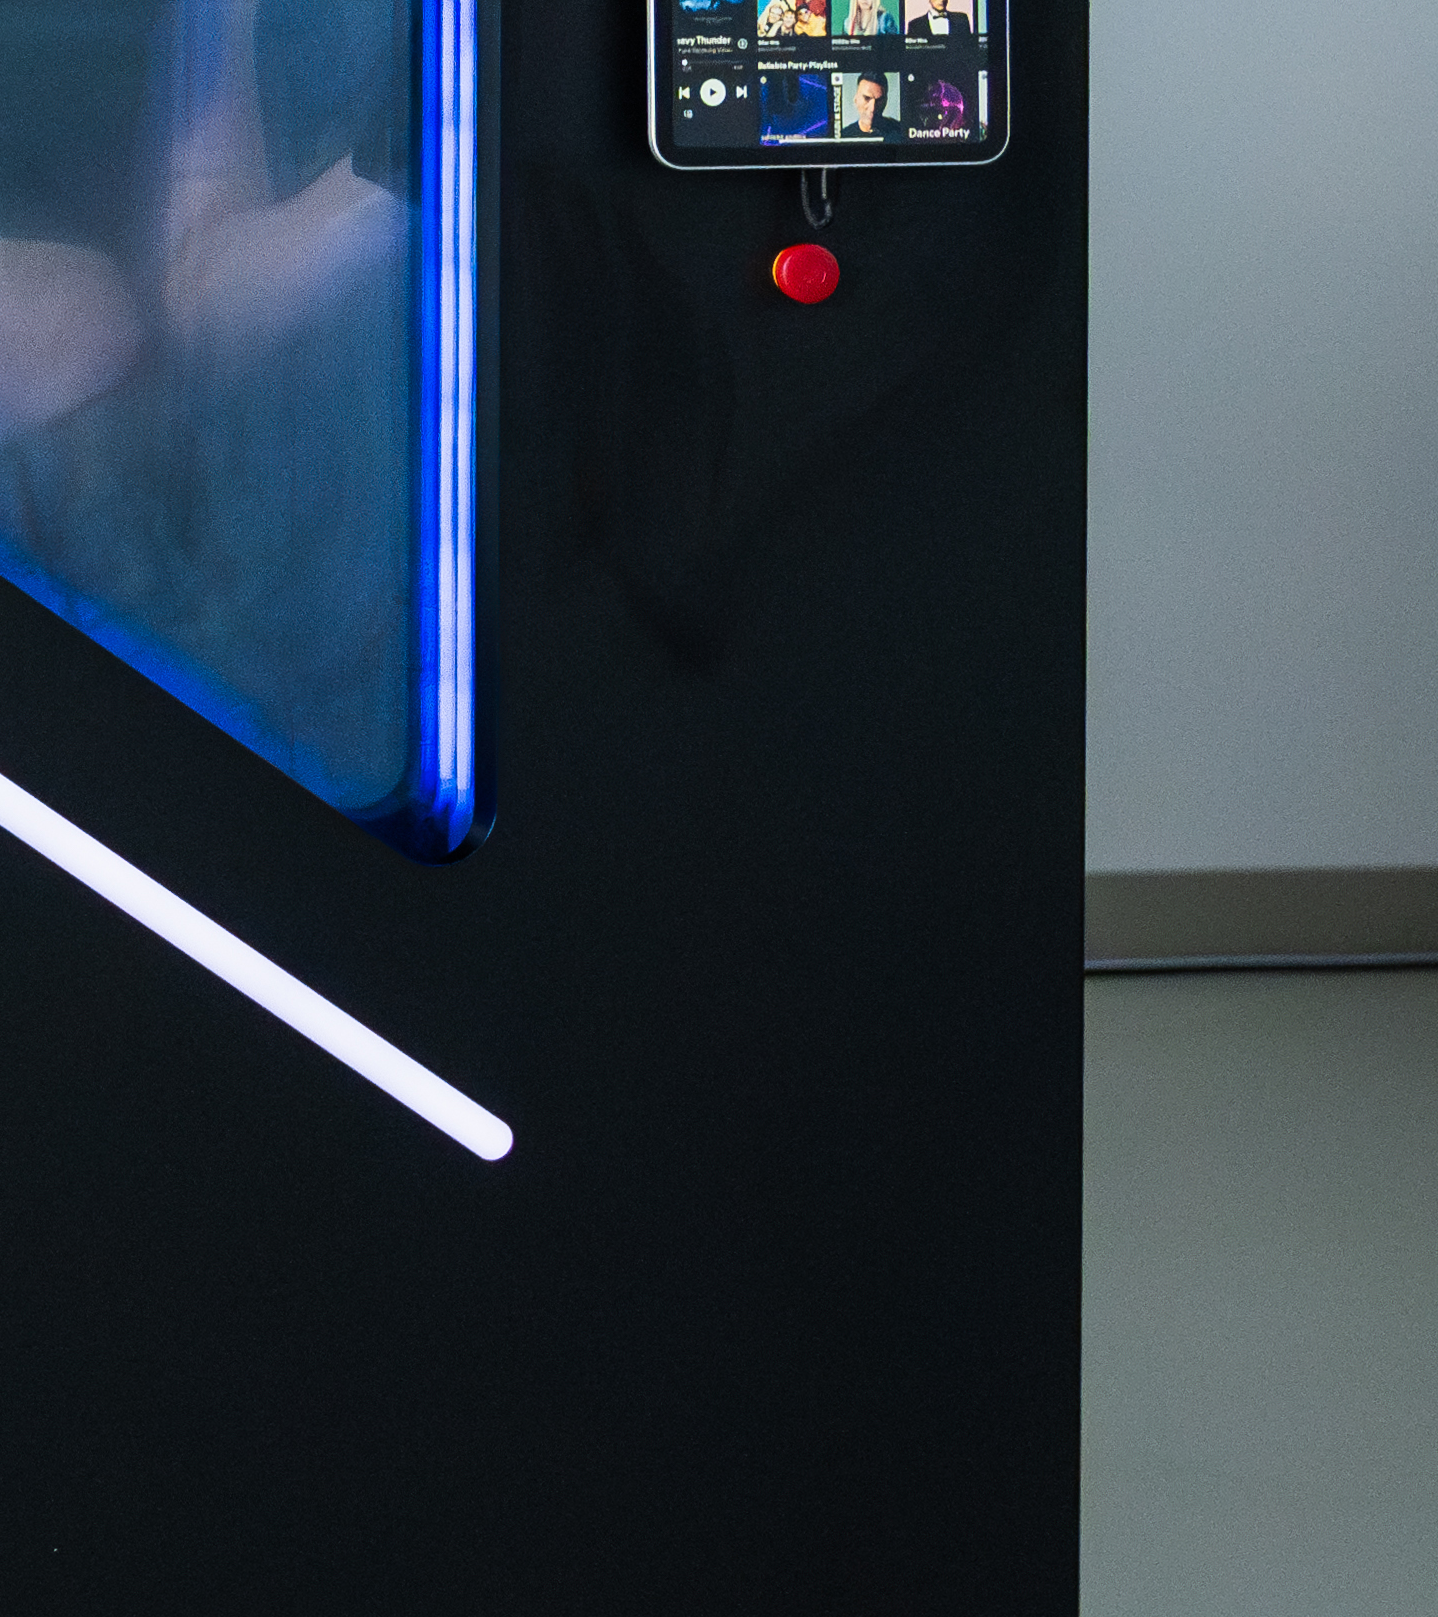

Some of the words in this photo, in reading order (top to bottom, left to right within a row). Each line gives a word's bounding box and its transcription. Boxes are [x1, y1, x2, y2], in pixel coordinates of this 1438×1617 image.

[696, 35, 731, 46] Thunder
[909, 127, 941, 139] Dance
[942, 127, 970, 140] Party
